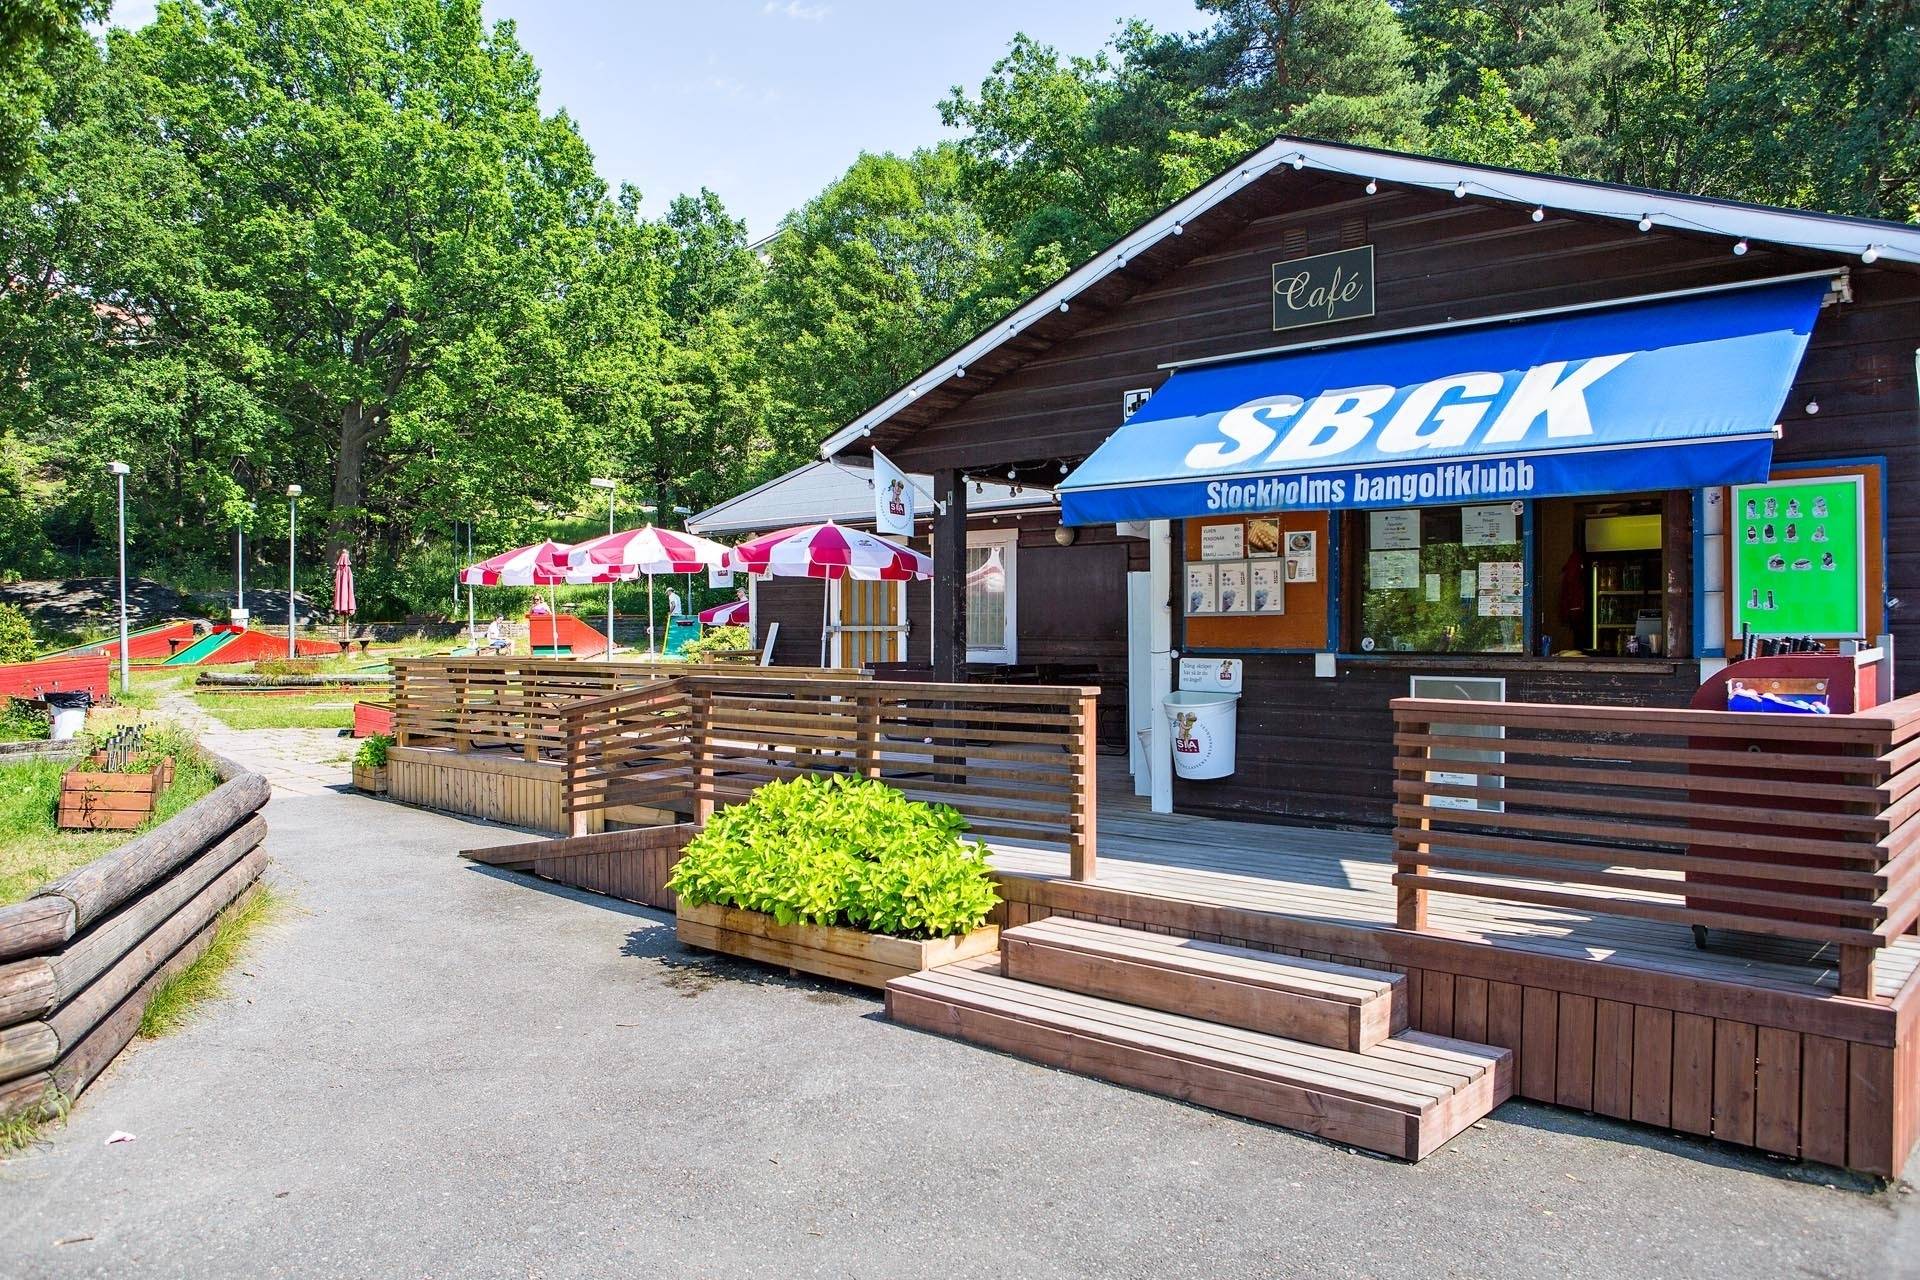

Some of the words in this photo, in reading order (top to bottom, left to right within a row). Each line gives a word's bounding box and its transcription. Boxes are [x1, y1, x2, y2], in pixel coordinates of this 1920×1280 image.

[1275, 266, 1363, 319] Café
[1184, 352, 1637, 469] SBGK
[1207, 475, 1346, 510] Stockholms
[1353, 459, 1534, 502] bangolfklubb
[1177, 739, 1197, 749] SIA
